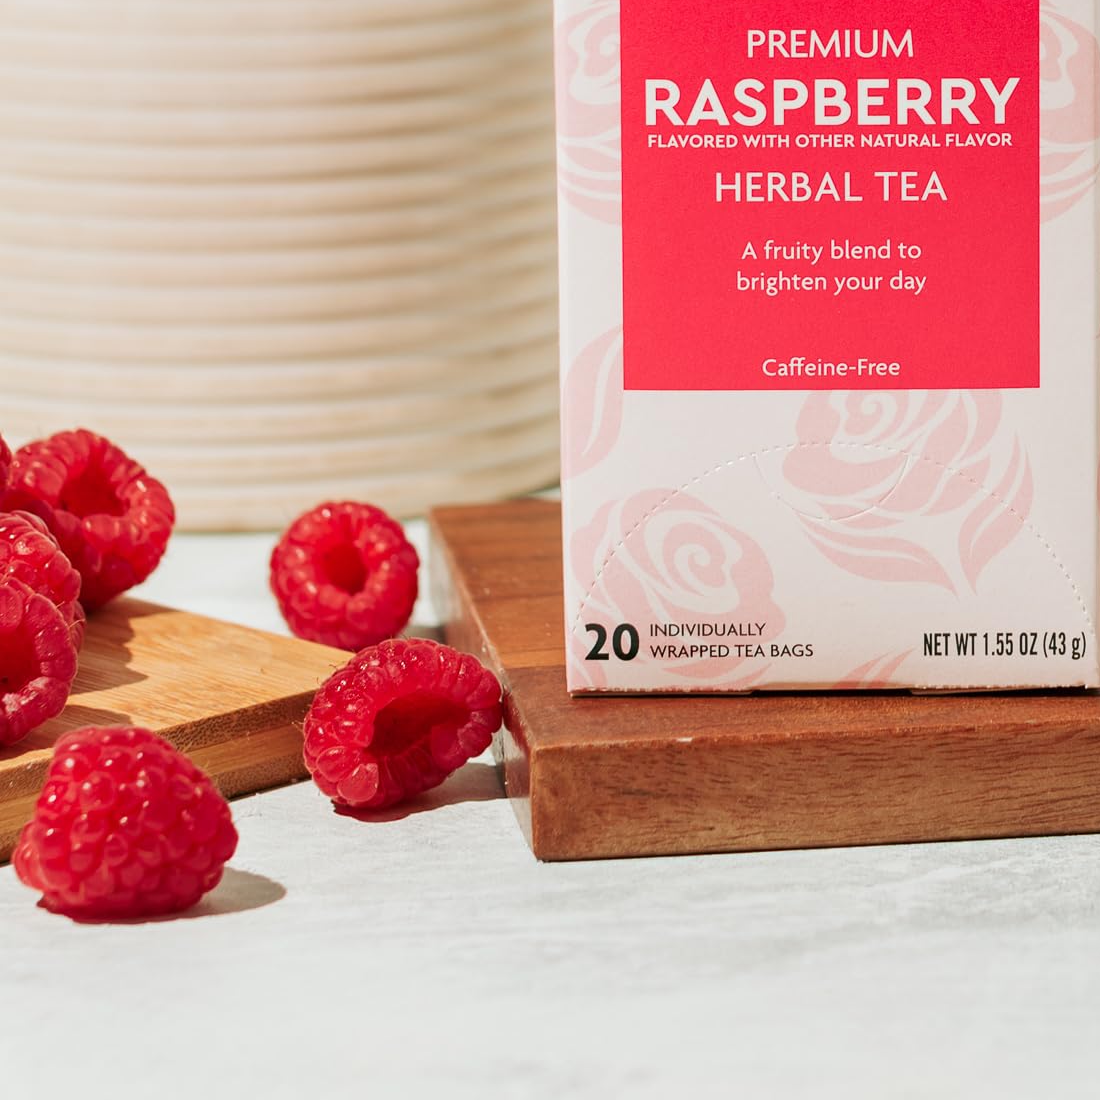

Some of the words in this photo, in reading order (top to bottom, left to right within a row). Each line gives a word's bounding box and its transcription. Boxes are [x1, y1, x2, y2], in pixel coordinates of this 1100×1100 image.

[747, 29, 914, 58] PREMIUM
[645, 77, 1020, 127] RASPBERRY
[648, 134, 738, 148] FLAVORED
[742, 134, 790, 148] WITH
[795, 134, 855, 148] OTHER
[860, 133, 941, 147] NATURAL
[945, 132, 1013, 147] FLAVOR
[716, 171, 863, 202] HERBAL
[874, 171, 948, 201] TEA
[741, 241, 758, 260] A
[764, 239, 823, 265] fruity
[830, 239, 891, 260] blend
[898, 241, 922, 260] to
[737, 270, 827, 296] brighten
[834, 276, 883, 296] your
[889, 269, 927, 296] day
[762, 357, 901, 377] Caffeine-Free
[585, 624, 640, 662] 20
[649, 623, 766, 637] INDIVIDUALLY
[649, 644, 730, 658] WRAPPED
[734, 644, 765, 658] TEA
[770, 644, 814, 657] BAGS
[923, 632, 950, 657] NET
[954, 632, 979, 656] WT
[983, 632, 1014, 656] 1.55
[1019, 632, 1038, 656] OZ
[1043, 632, 1066, 658] (43
[1071, 631, 1087, 661] g)
